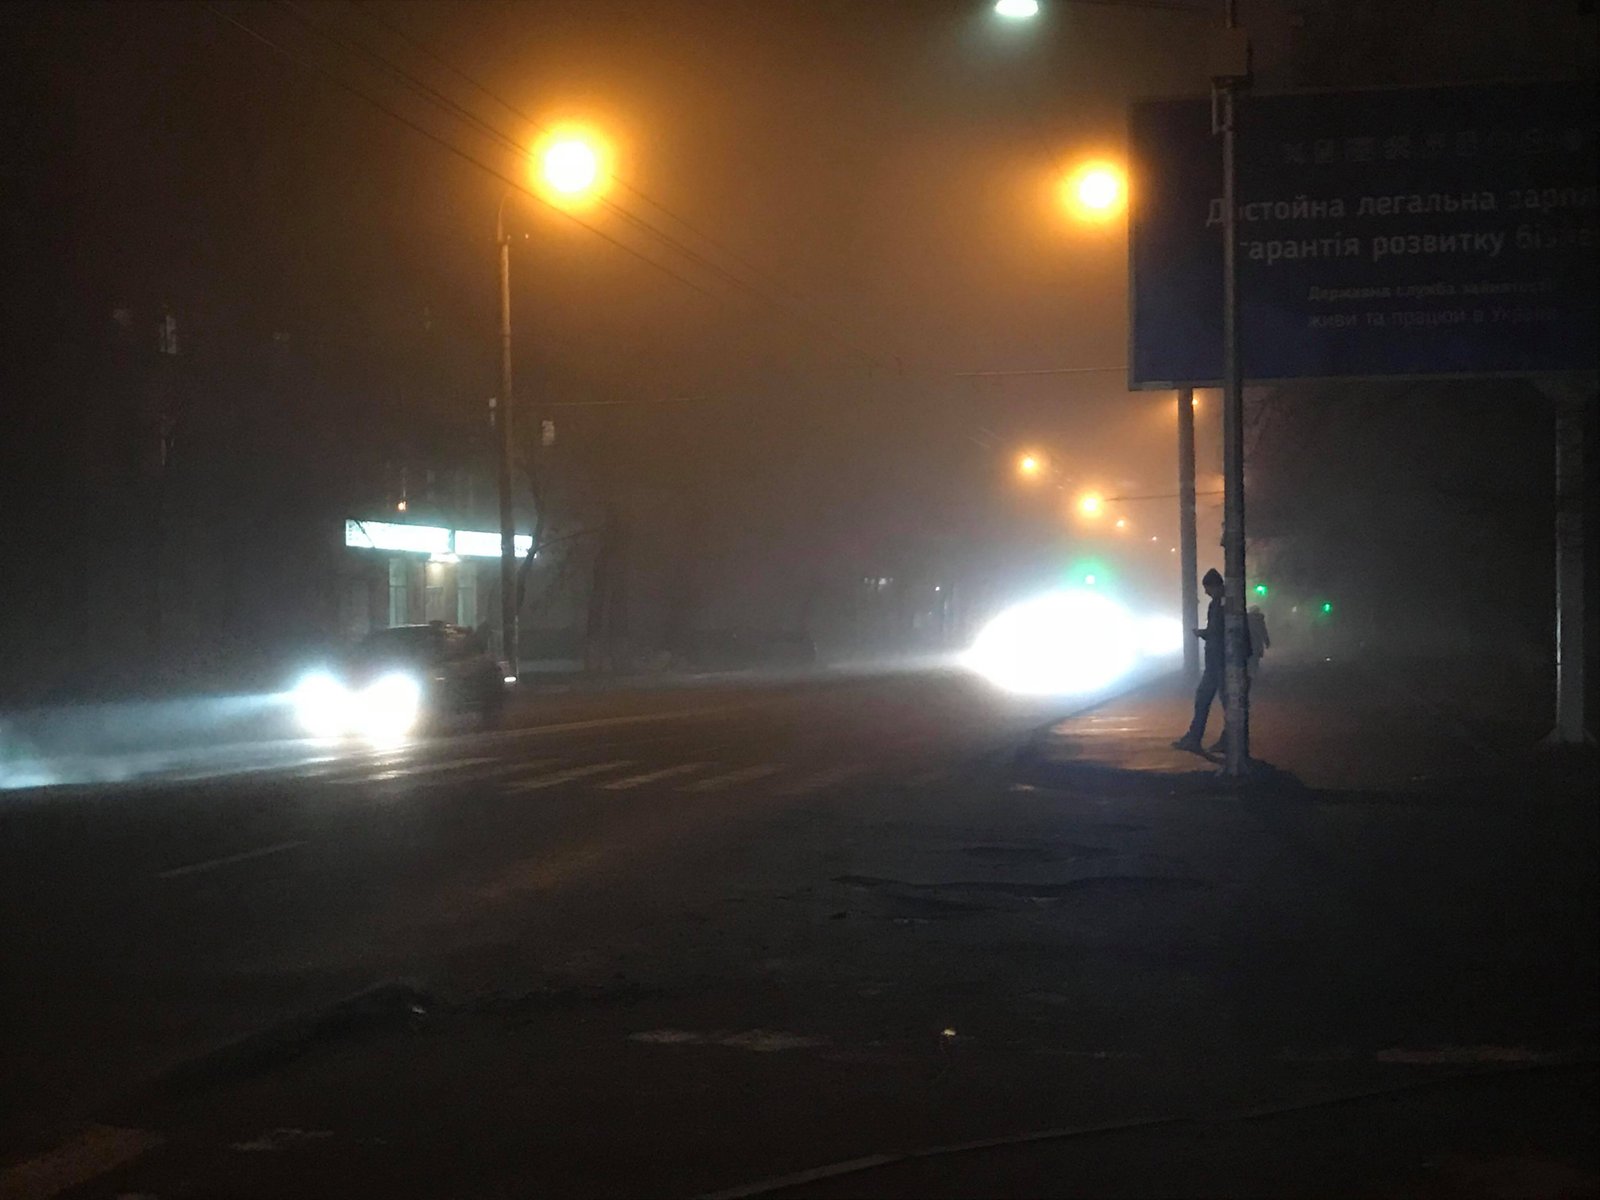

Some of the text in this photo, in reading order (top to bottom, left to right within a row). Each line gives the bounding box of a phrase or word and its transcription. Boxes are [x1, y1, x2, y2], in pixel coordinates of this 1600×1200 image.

[1205, 194, 1345, 227] Дстойна
[1357, 190, 1496, 217] легальна
[1372, 231, 1505, 262] розвитку
[1307, 313, 1357, 328] живи
[1366, 311, 1386, 327] та
